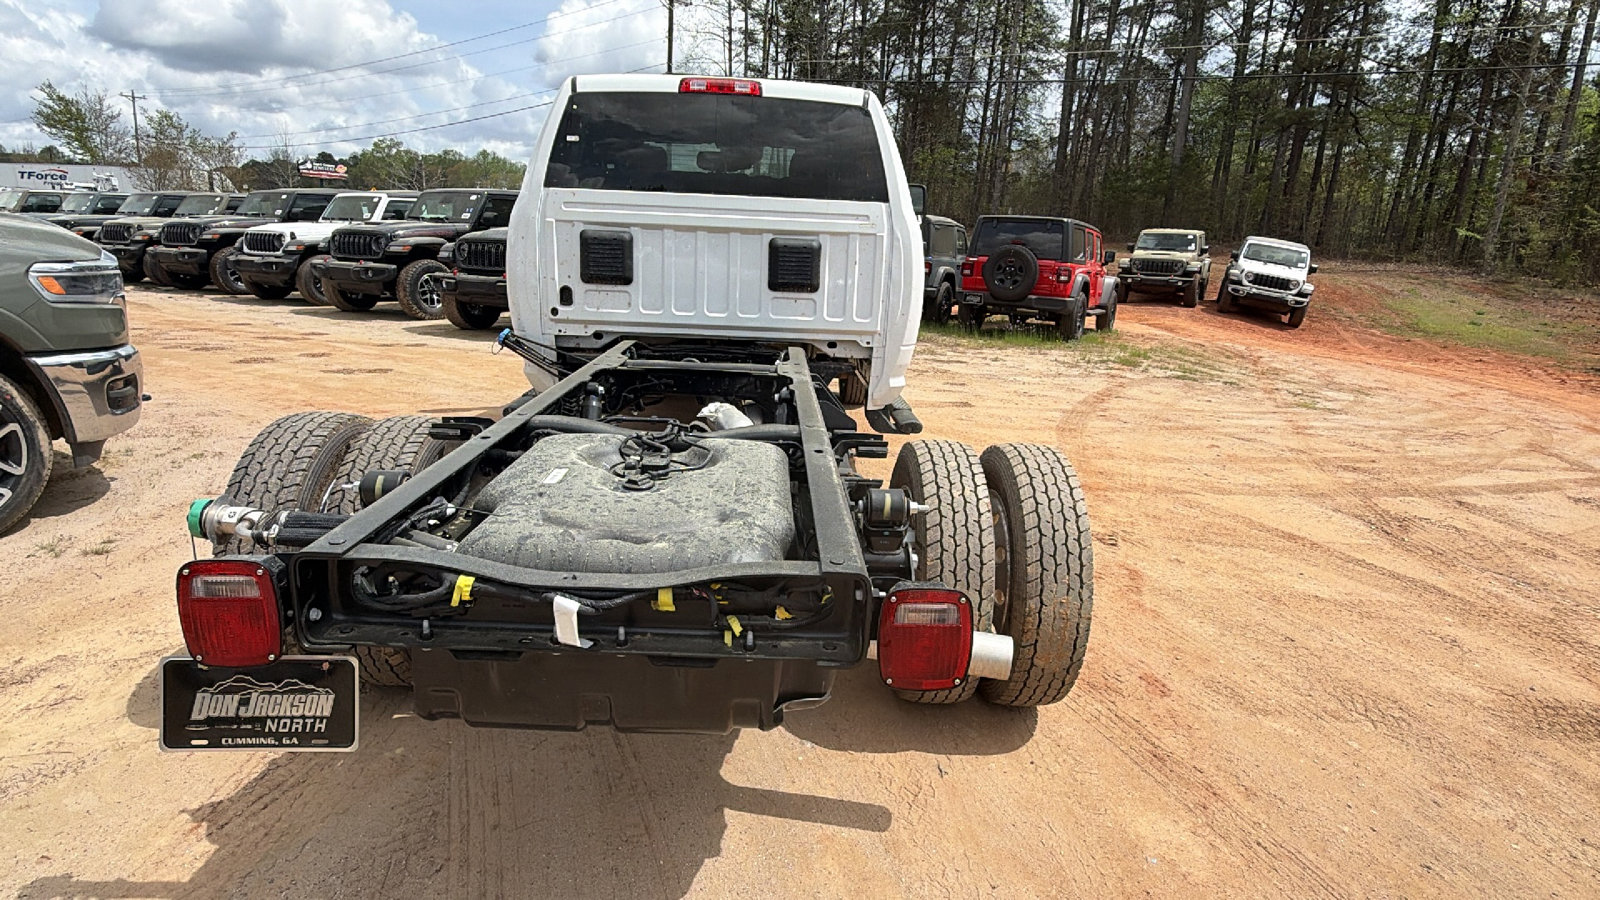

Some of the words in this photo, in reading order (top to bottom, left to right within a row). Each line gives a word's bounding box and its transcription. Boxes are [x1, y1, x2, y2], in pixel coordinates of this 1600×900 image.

[18, 171, 67, 180] TForce
[190, 692, 240, 720] DON
[238, 691, 335, 717] JACKSON
[264, 718, 327, 733] NORTH
[221, 737, 279, 746] CUMMING,
[282, 737, 299, 745] GA
